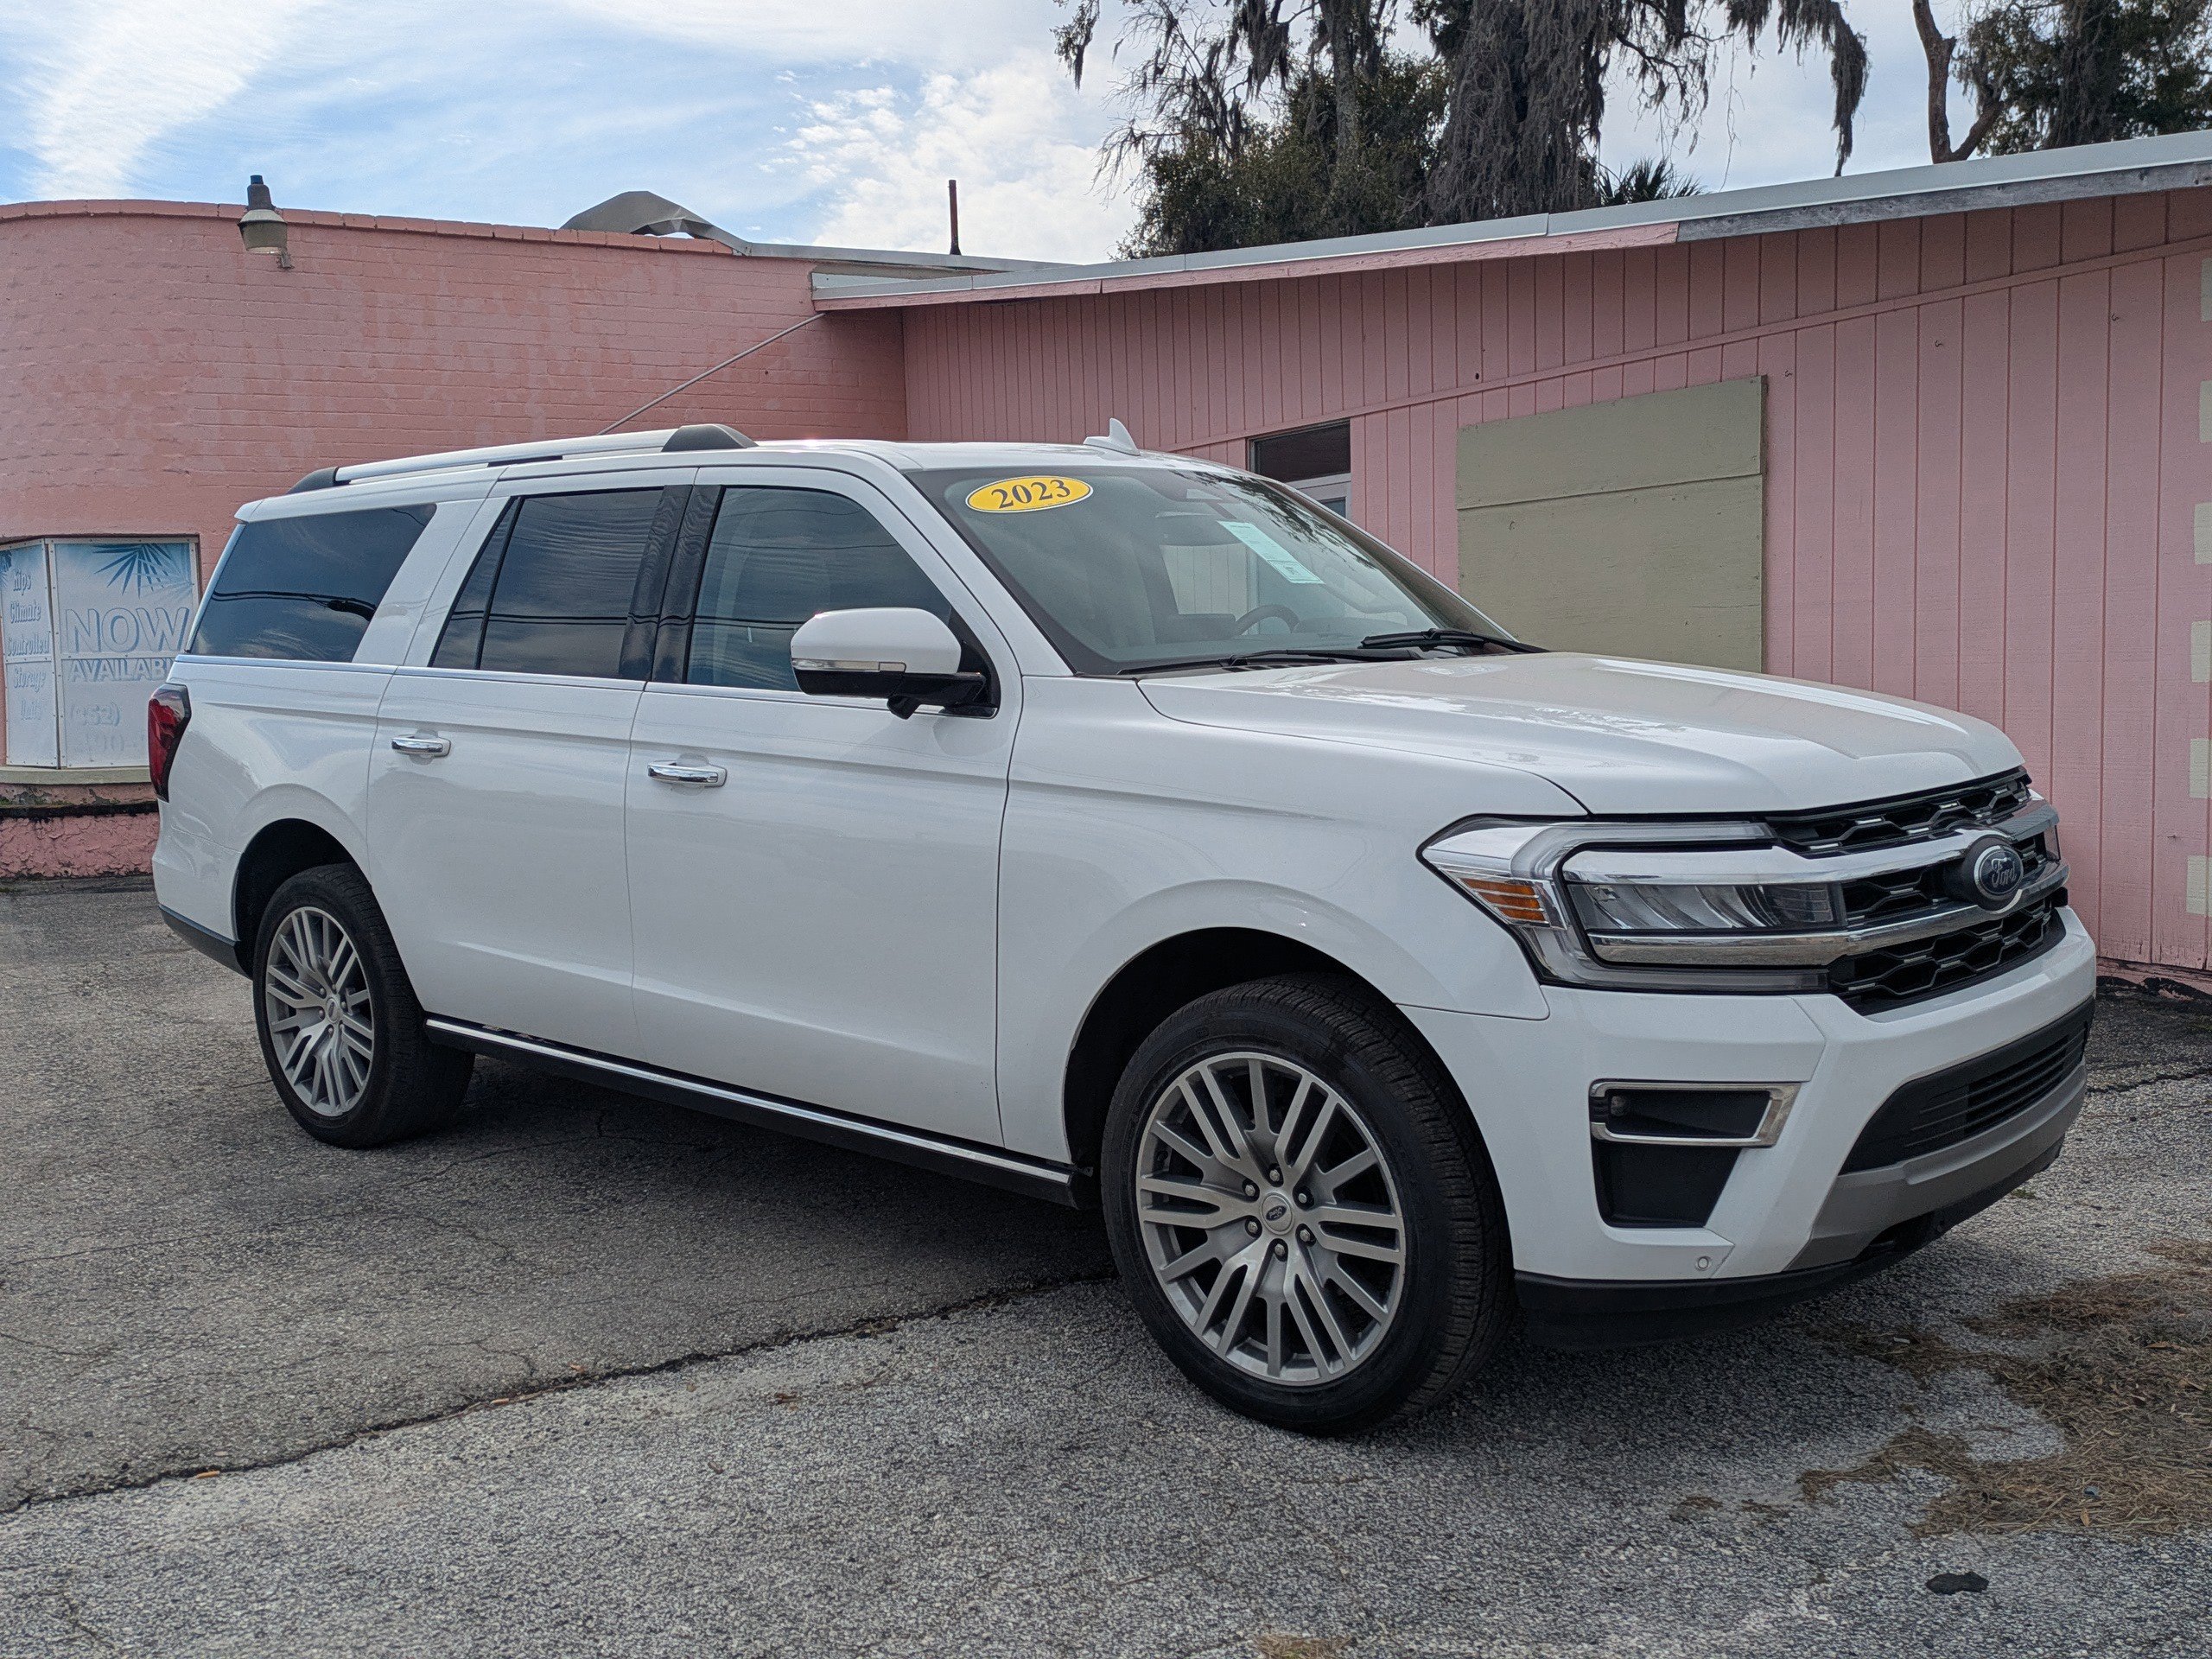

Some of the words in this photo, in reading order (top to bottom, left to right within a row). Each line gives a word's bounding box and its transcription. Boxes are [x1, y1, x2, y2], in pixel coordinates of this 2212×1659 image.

[991, 480, 1071, 509] 2023
[10, 600, 41, 624] Climate
[8, 632, 50, 657] Controlled
[65, 607, 190, 654] NOW
[1991, 856, 2017, 888] Ford
